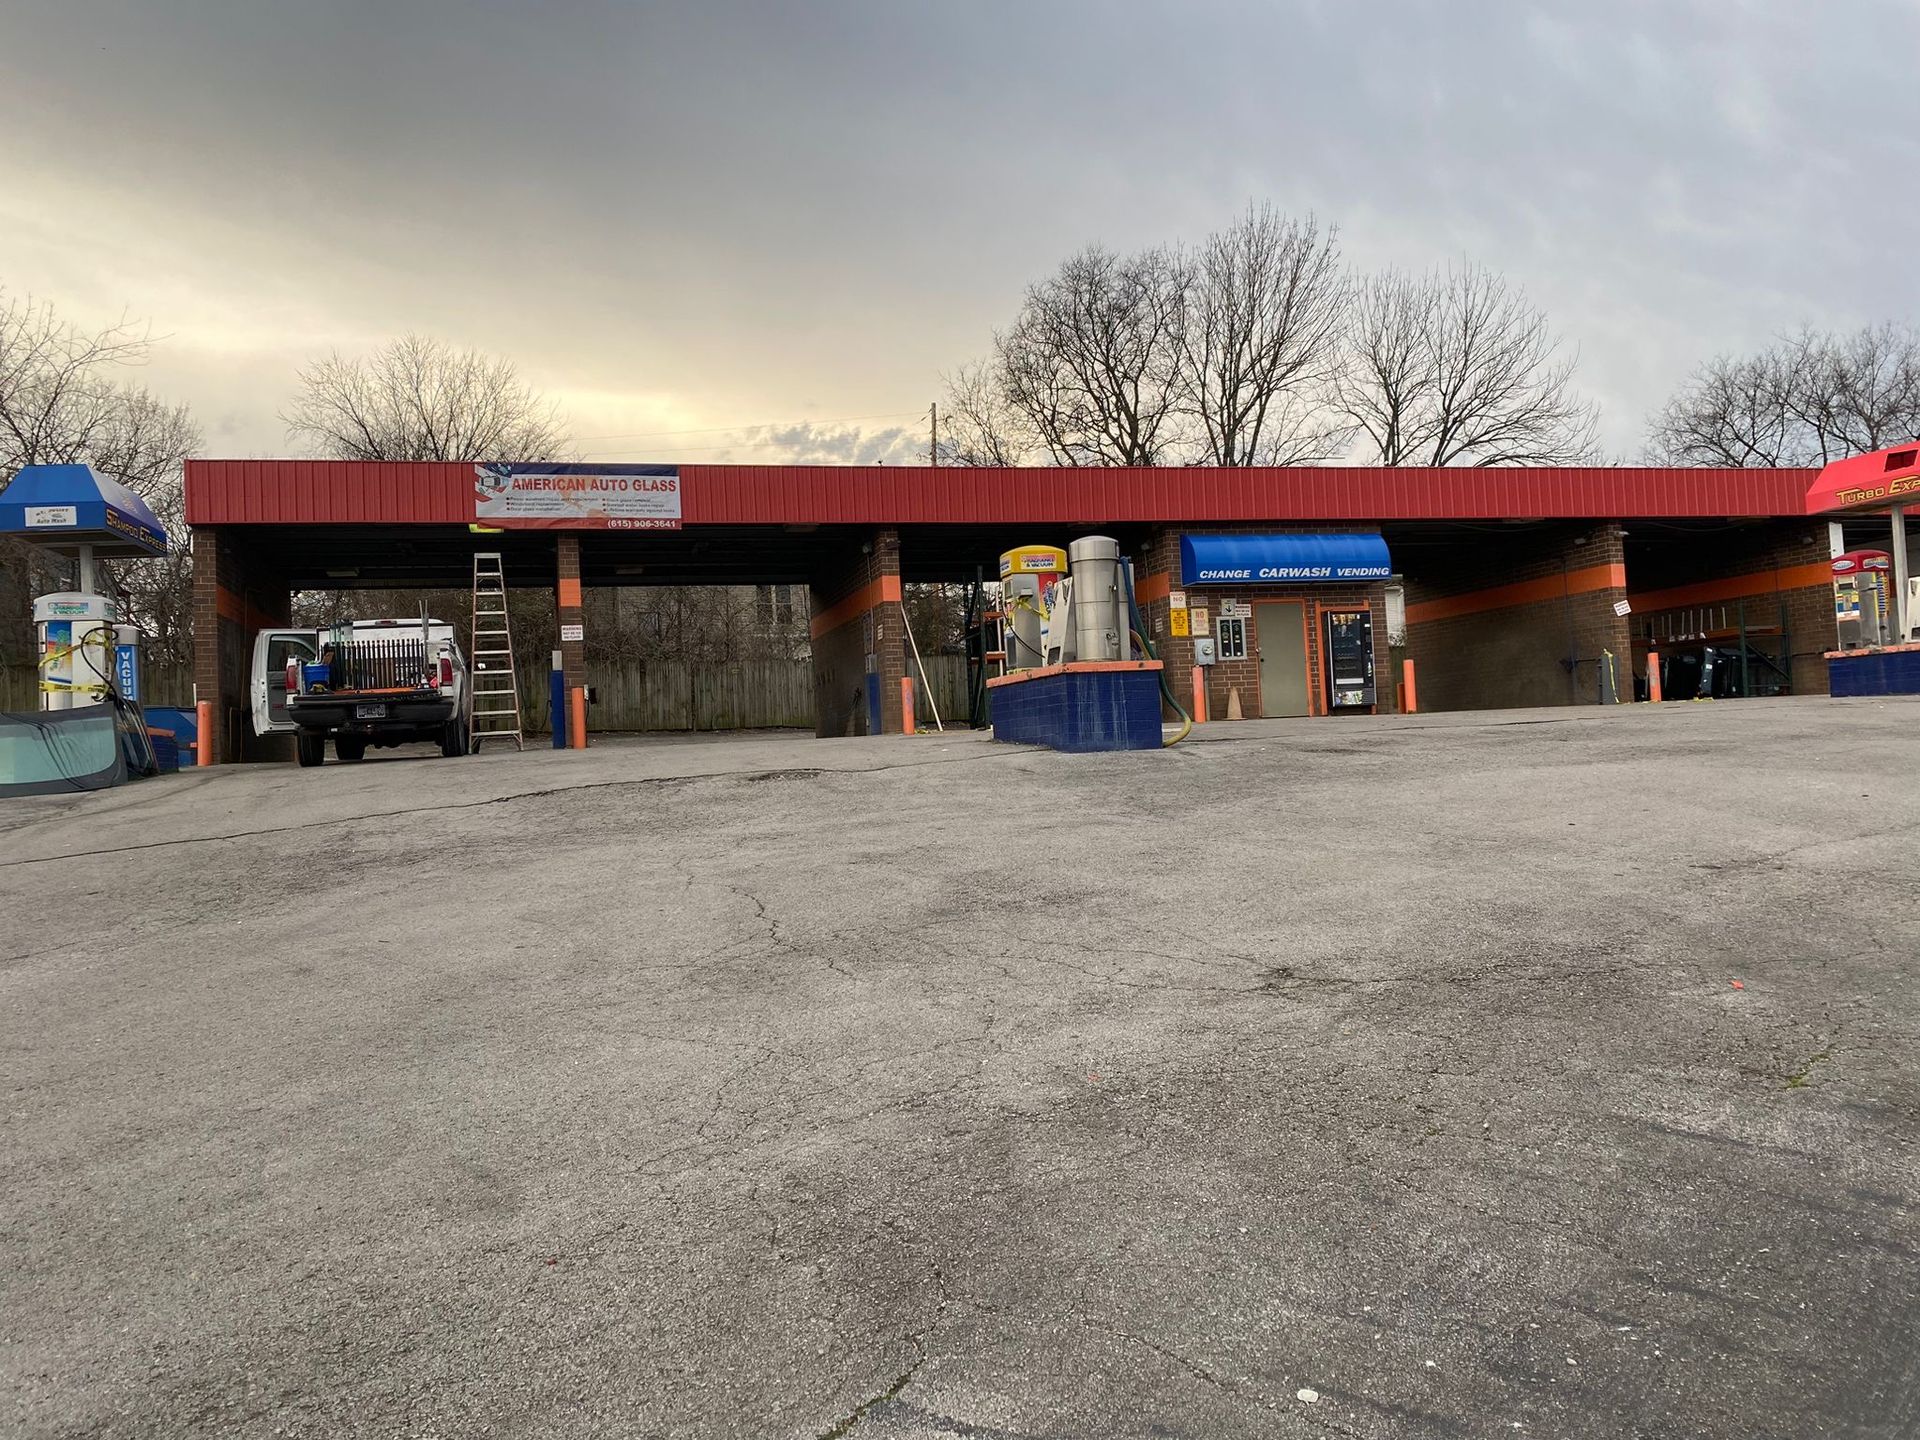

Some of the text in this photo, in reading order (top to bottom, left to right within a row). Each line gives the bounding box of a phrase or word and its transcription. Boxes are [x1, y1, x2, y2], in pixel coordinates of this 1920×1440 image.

[512, 478, 676, 492] AMERICAN AUTO GLASS
[1836, 486, 1885, 505] TURBO
[106, 508, 167, 552] SHAMPOO EXPRESS
[607, 520, 632, 528] (615)
[1199, 567, 1390, 579] CHANGE CARWASH VENDING
